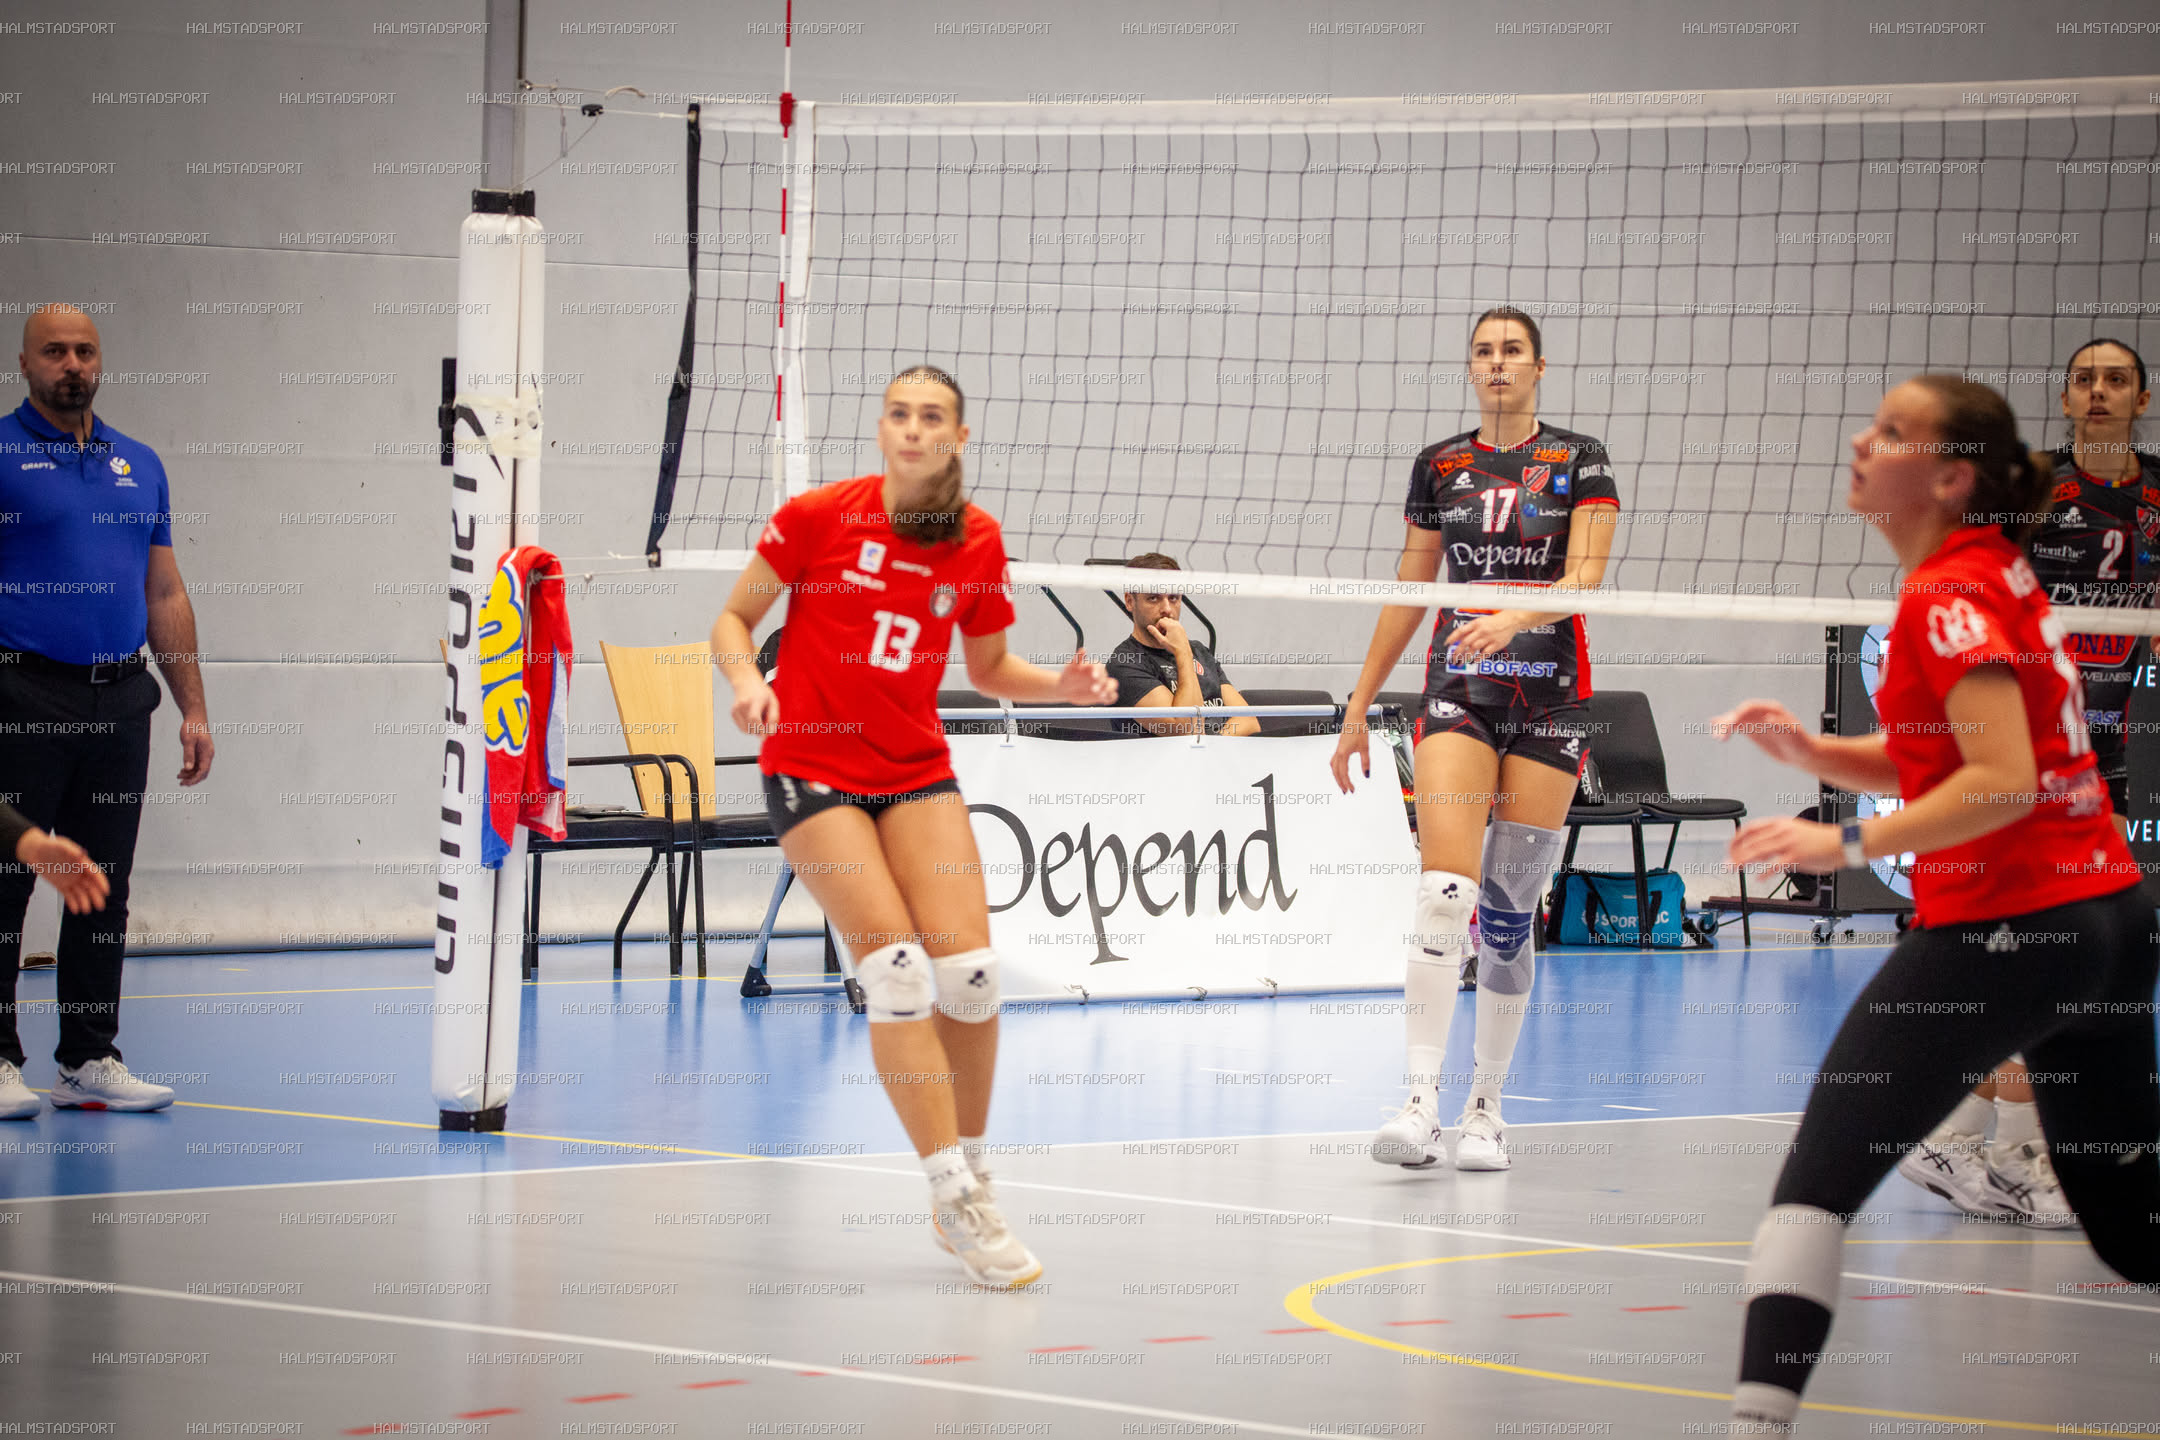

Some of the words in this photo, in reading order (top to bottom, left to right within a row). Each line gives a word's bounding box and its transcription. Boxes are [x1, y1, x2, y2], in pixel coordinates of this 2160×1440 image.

[1480, 488, 1517, 533] 17
[1450, 536, 1552, 577] Depend
[2097, 529, 2125, 580] 2
[869, 609, 921, 673] 13
[1479, 660, 1558, 678] BOFAST
[968, 773, 1298, 965] Depend
